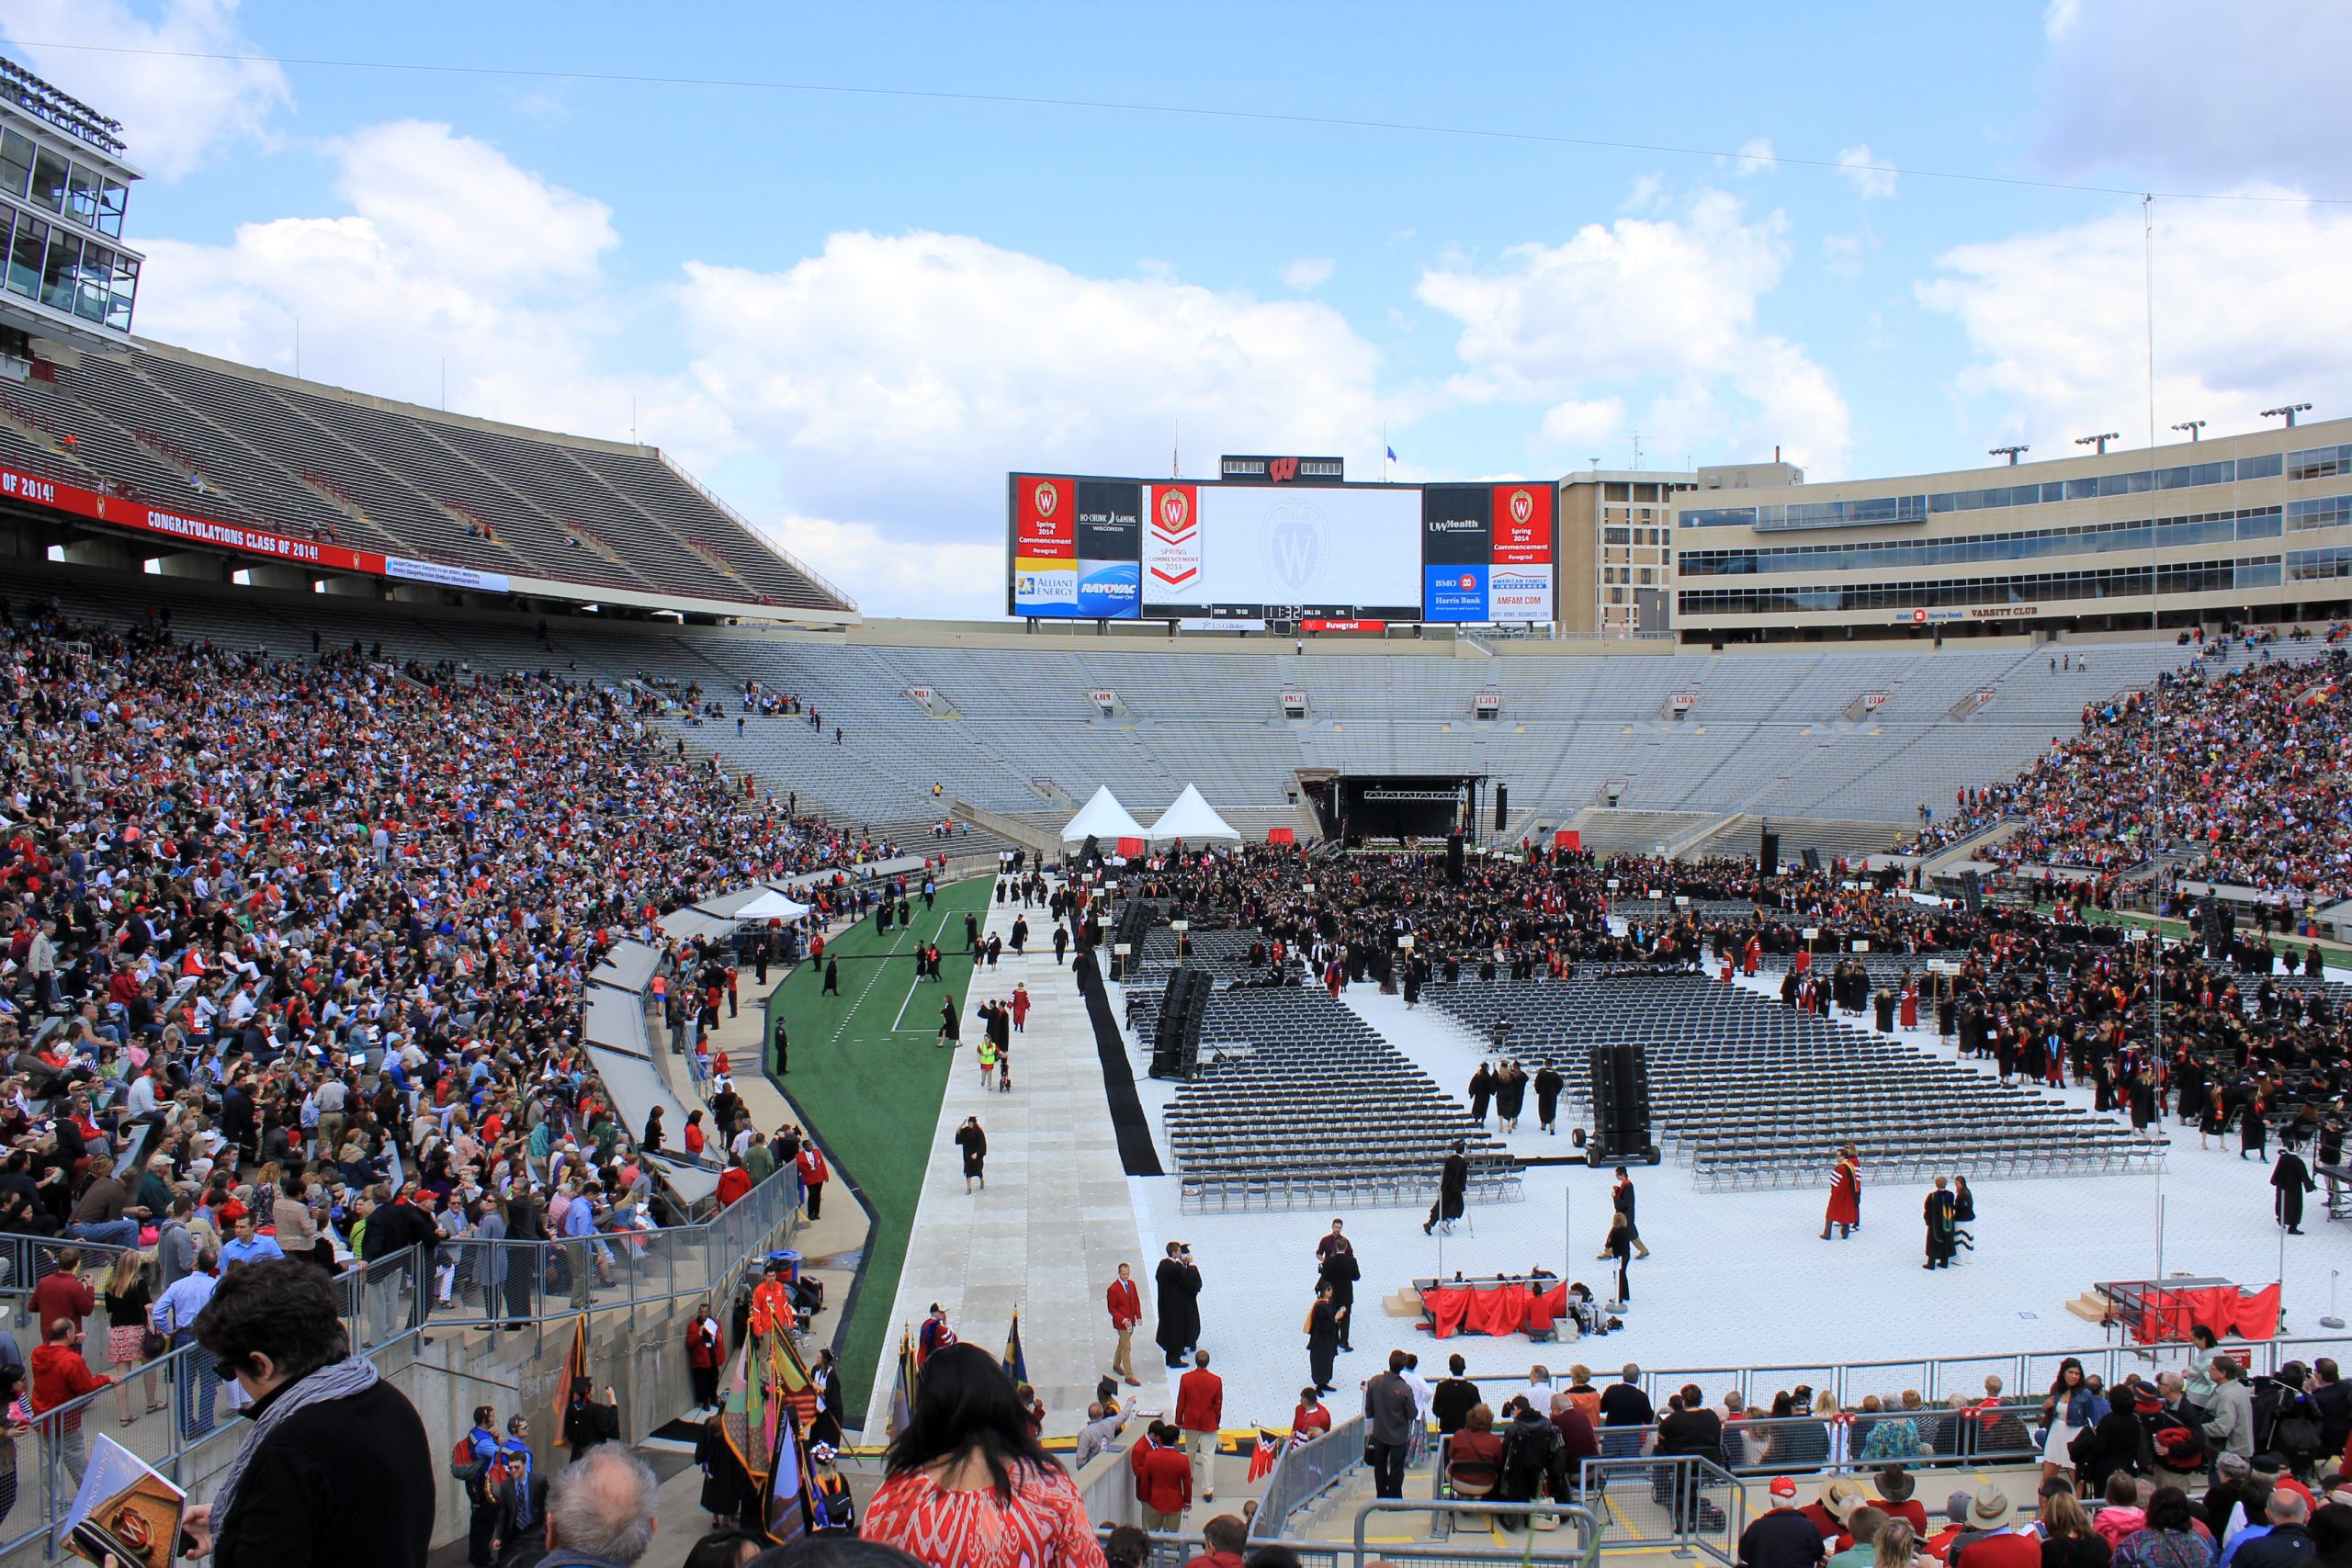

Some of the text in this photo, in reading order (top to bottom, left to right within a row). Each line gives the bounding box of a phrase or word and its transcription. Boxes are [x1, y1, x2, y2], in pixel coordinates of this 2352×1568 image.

[3, 472, 54, 502] OF 2014!
[1115, 515, 1136, 524] GAMING
[1036, 521, 1056, 529] Spring
[148, 511, 319, 559] CONGRATULATIONS CLASS OF 2014!
[1019, 536, 1072, 545] Commencement
[1037, 578, 1073, 588] ALLIANT
[1037, 588, 1073, 596] ENERGY
[1080, 583, 1136, 594] RAYOVAC
[1497, 596, 1541, 604] AMFAM.COM
[2014, 607, 2038, 615] CLUB
[1326, 622, 1359, 631] #uwgrad
